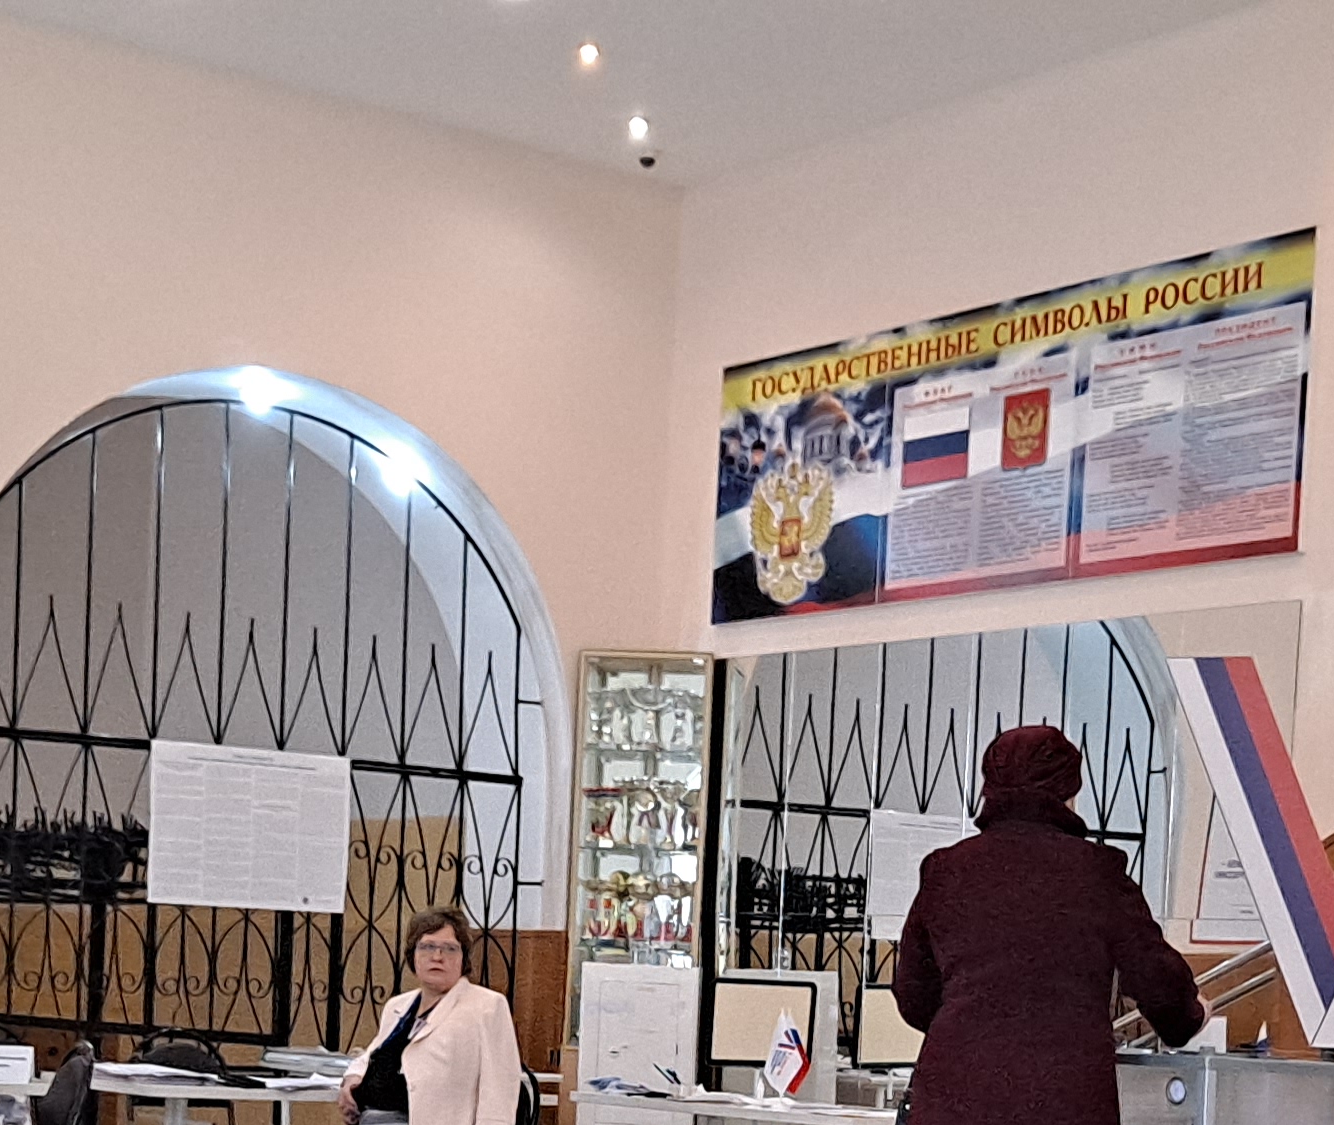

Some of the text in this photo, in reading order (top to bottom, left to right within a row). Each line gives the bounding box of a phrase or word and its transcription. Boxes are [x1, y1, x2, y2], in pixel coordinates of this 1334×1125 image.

[751, 261, 1265, 401] ГОСУДАРСТВЕННЫЕ СИМВОЛЫ РОССИИ
